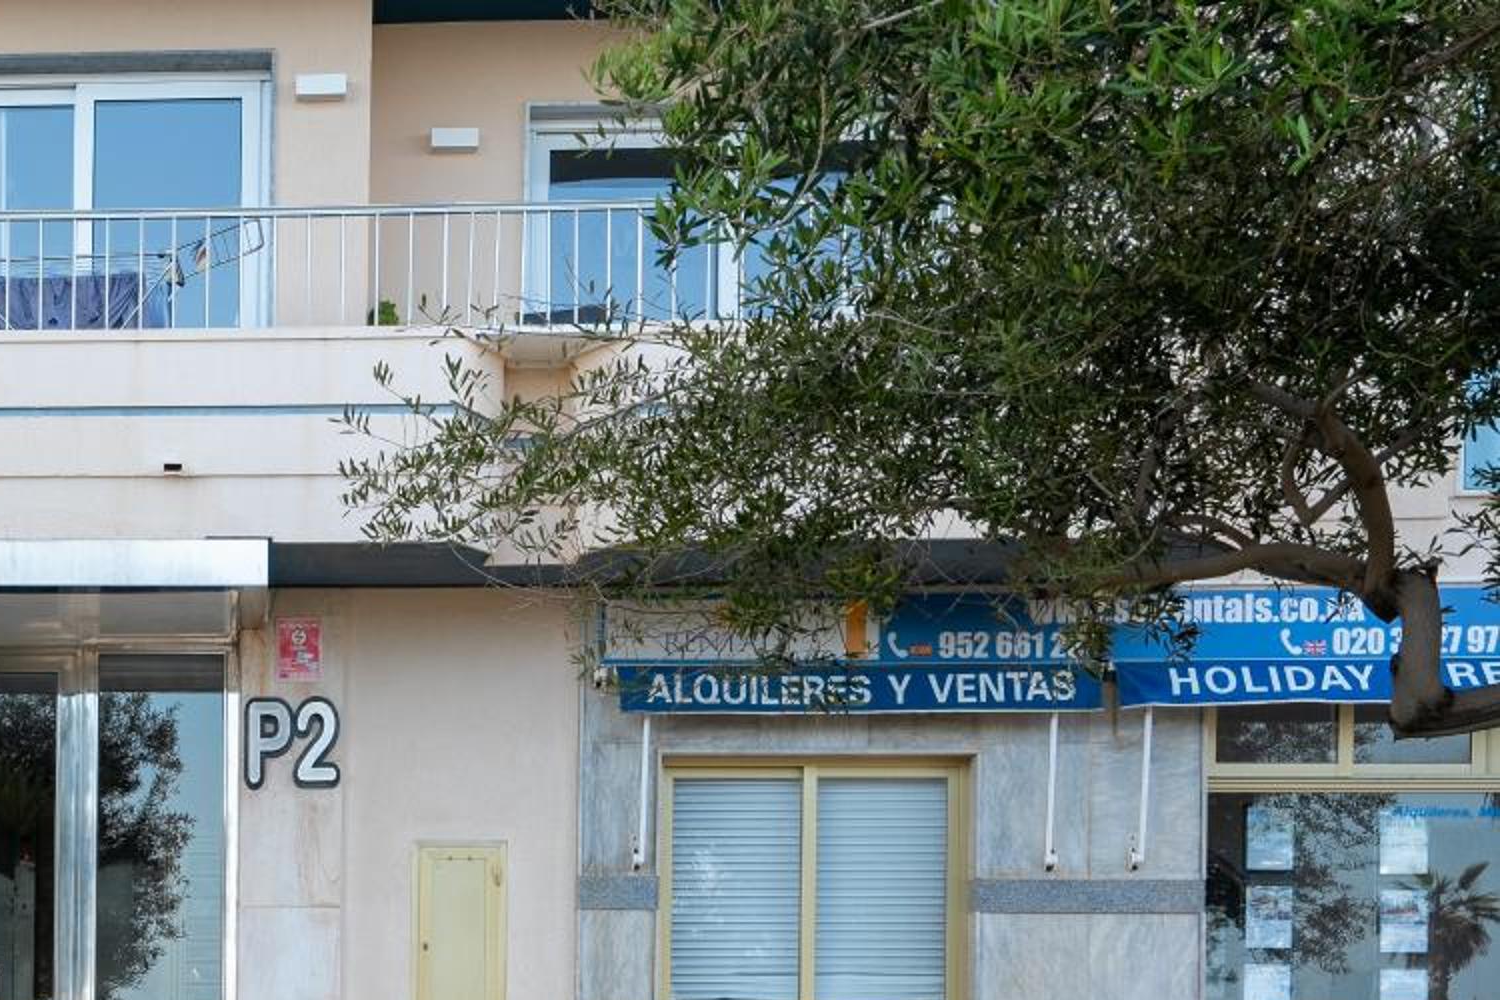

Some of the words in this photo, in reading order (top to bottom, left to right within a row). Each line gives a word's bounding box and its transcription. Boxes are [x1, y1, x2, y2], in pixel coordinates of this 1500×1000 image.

[938, 631, 990, 659] 952
[1332, 627, 1385, 655] 020
[647, 673, 872, 705] ALQUILERES
[887, 673, 911, 704] Y
[928, 670, 1077, 703] VENTAS
[1169, 664, 1374, 696] HOLIDAY
[244, 696, 340, 790] P2
